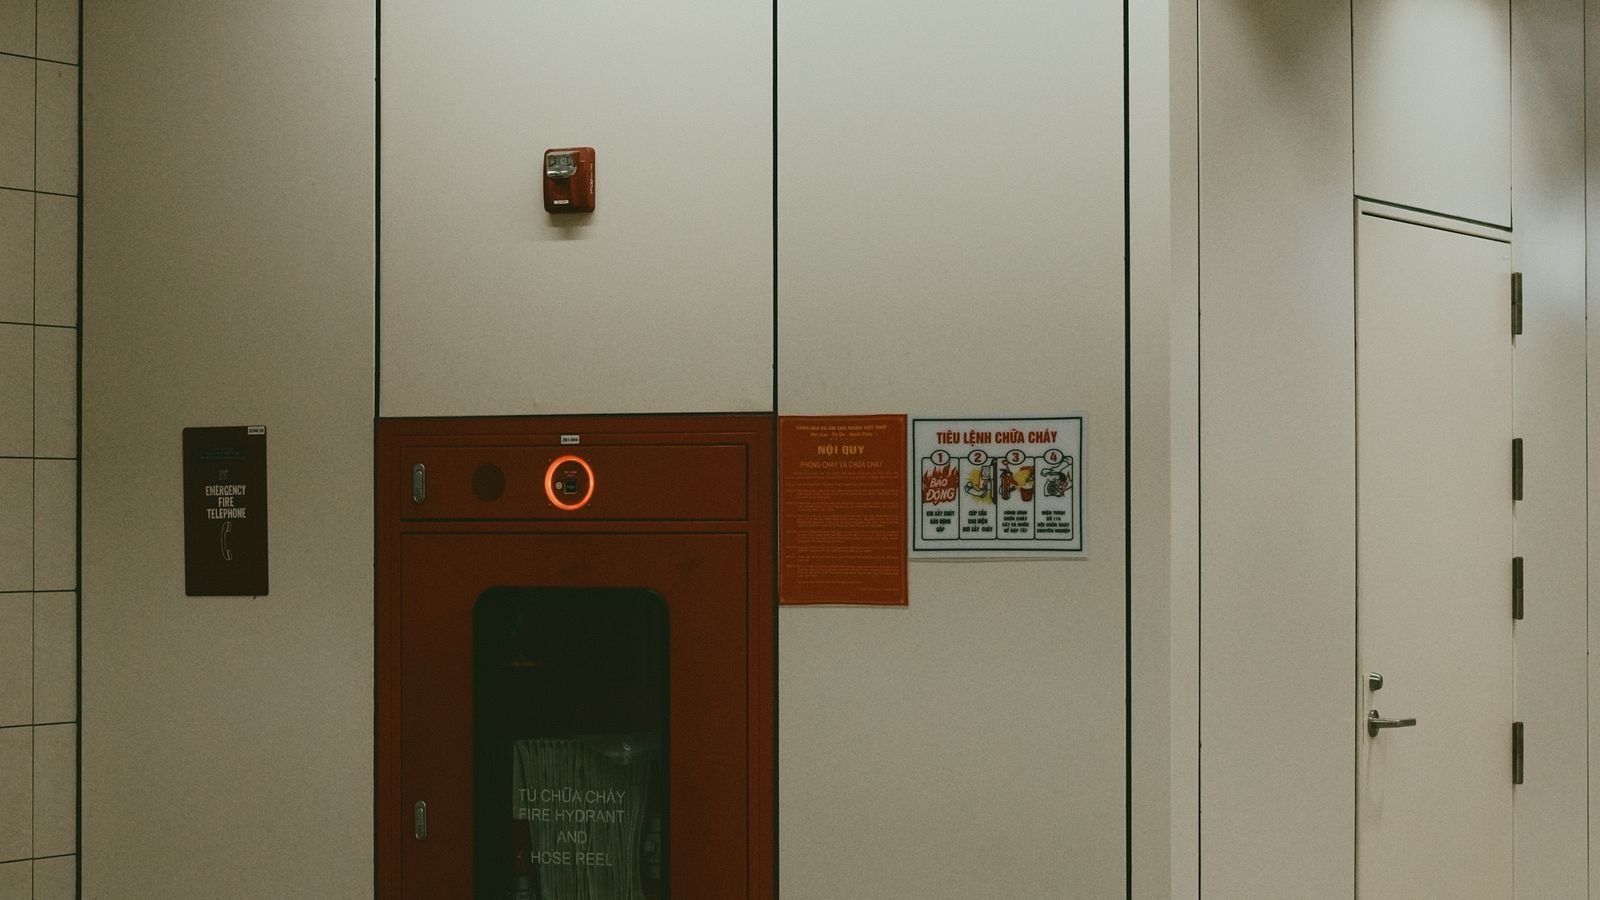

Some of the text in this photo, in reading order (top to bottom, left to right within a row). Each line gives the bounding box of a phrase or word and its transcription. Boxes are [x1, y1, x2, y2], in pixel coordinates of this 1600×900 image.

[936, 428, 1057, 446] TIÊU LỆNH CHỮA CHÁY
[817, 444, 865, 456] NỘI QUY
[938, 453, 943, 462] 1
[974, 453, 982, 462] 2
[1012, 453, 1020, 462] 3
[1050, 452, 1057, 462] 4
[205, 484, 246, 496] EMERGENCY
[218, 496, 234, 507] FIRE
[206, 508, 246, 519] TELEPHONE
[586, 788, 626, 804] CHÁY
[518, 808, 625, 823] FIRE HYDRANT
[557, 830, 588, 844] AND
[531, 851, 612, 866] HOSE REEL
